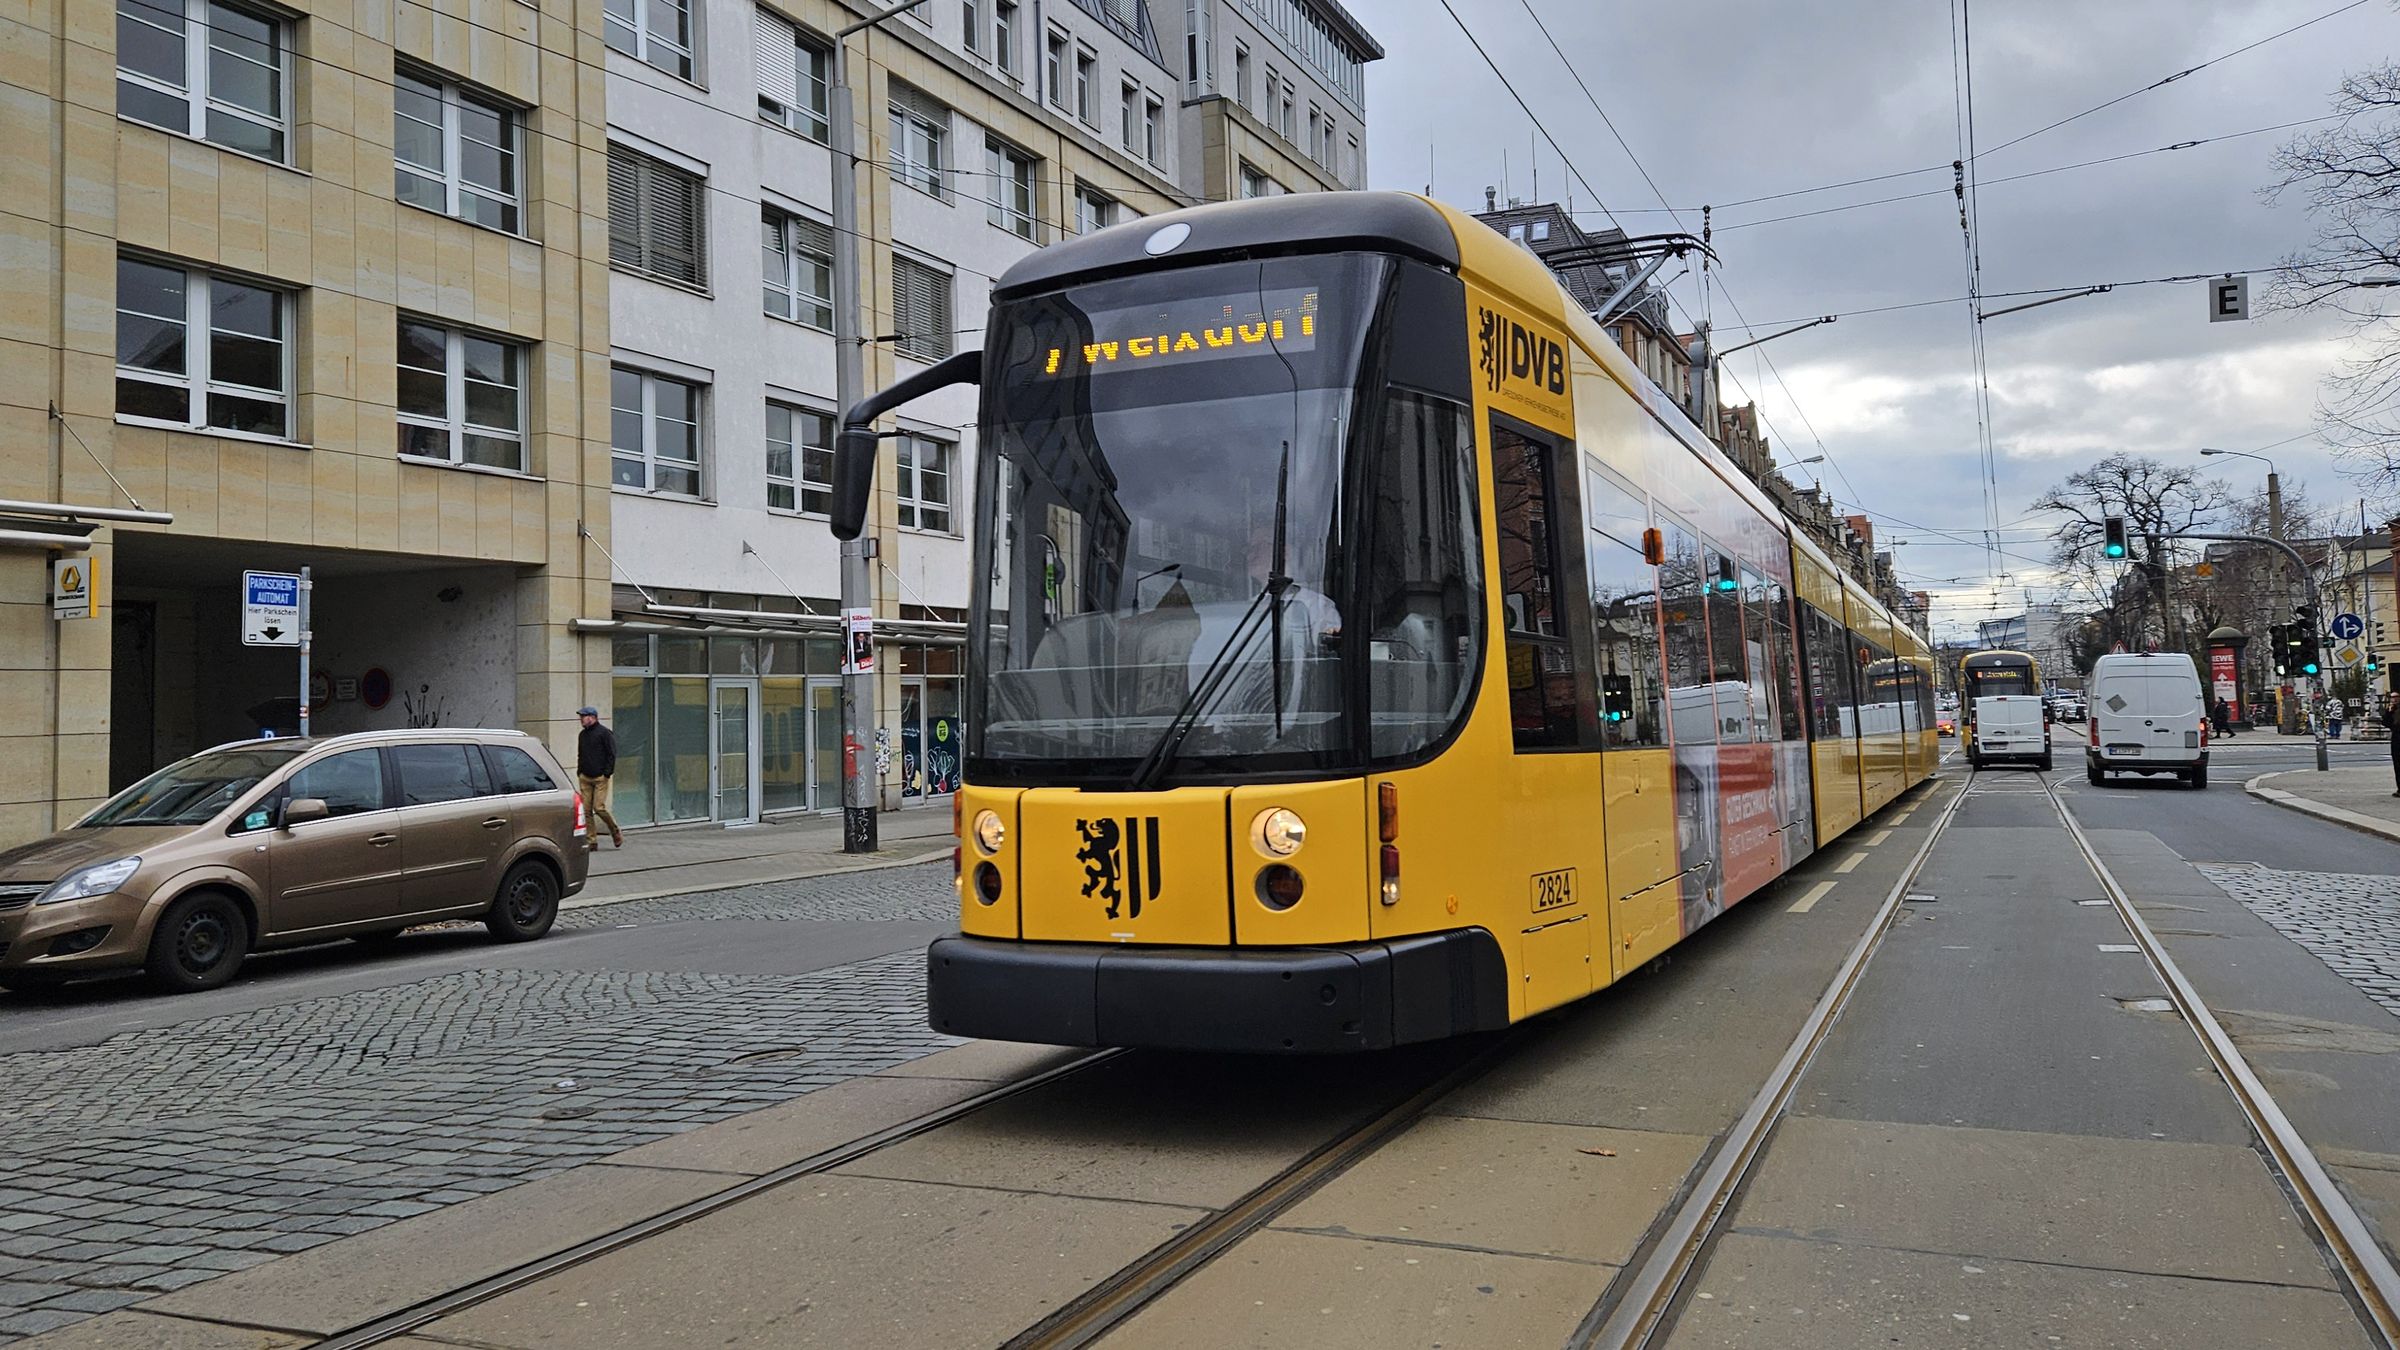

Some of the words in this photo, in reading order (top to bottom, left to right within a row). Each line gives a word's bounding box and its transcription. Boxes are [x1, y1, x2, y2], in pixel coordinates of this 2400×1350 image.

[2219, 285, 2239, 315] E
[1511, 321, 1565, 396] DVB
[250, 576, 296, 591] PARKSCHEIN-
[256, 591, 290, 605] AUTOMAT
[264, 607, 297, 616] Parkschein
[264, 615, 281, 624] lösen
[1538, 872, 1570, 908] 2824
